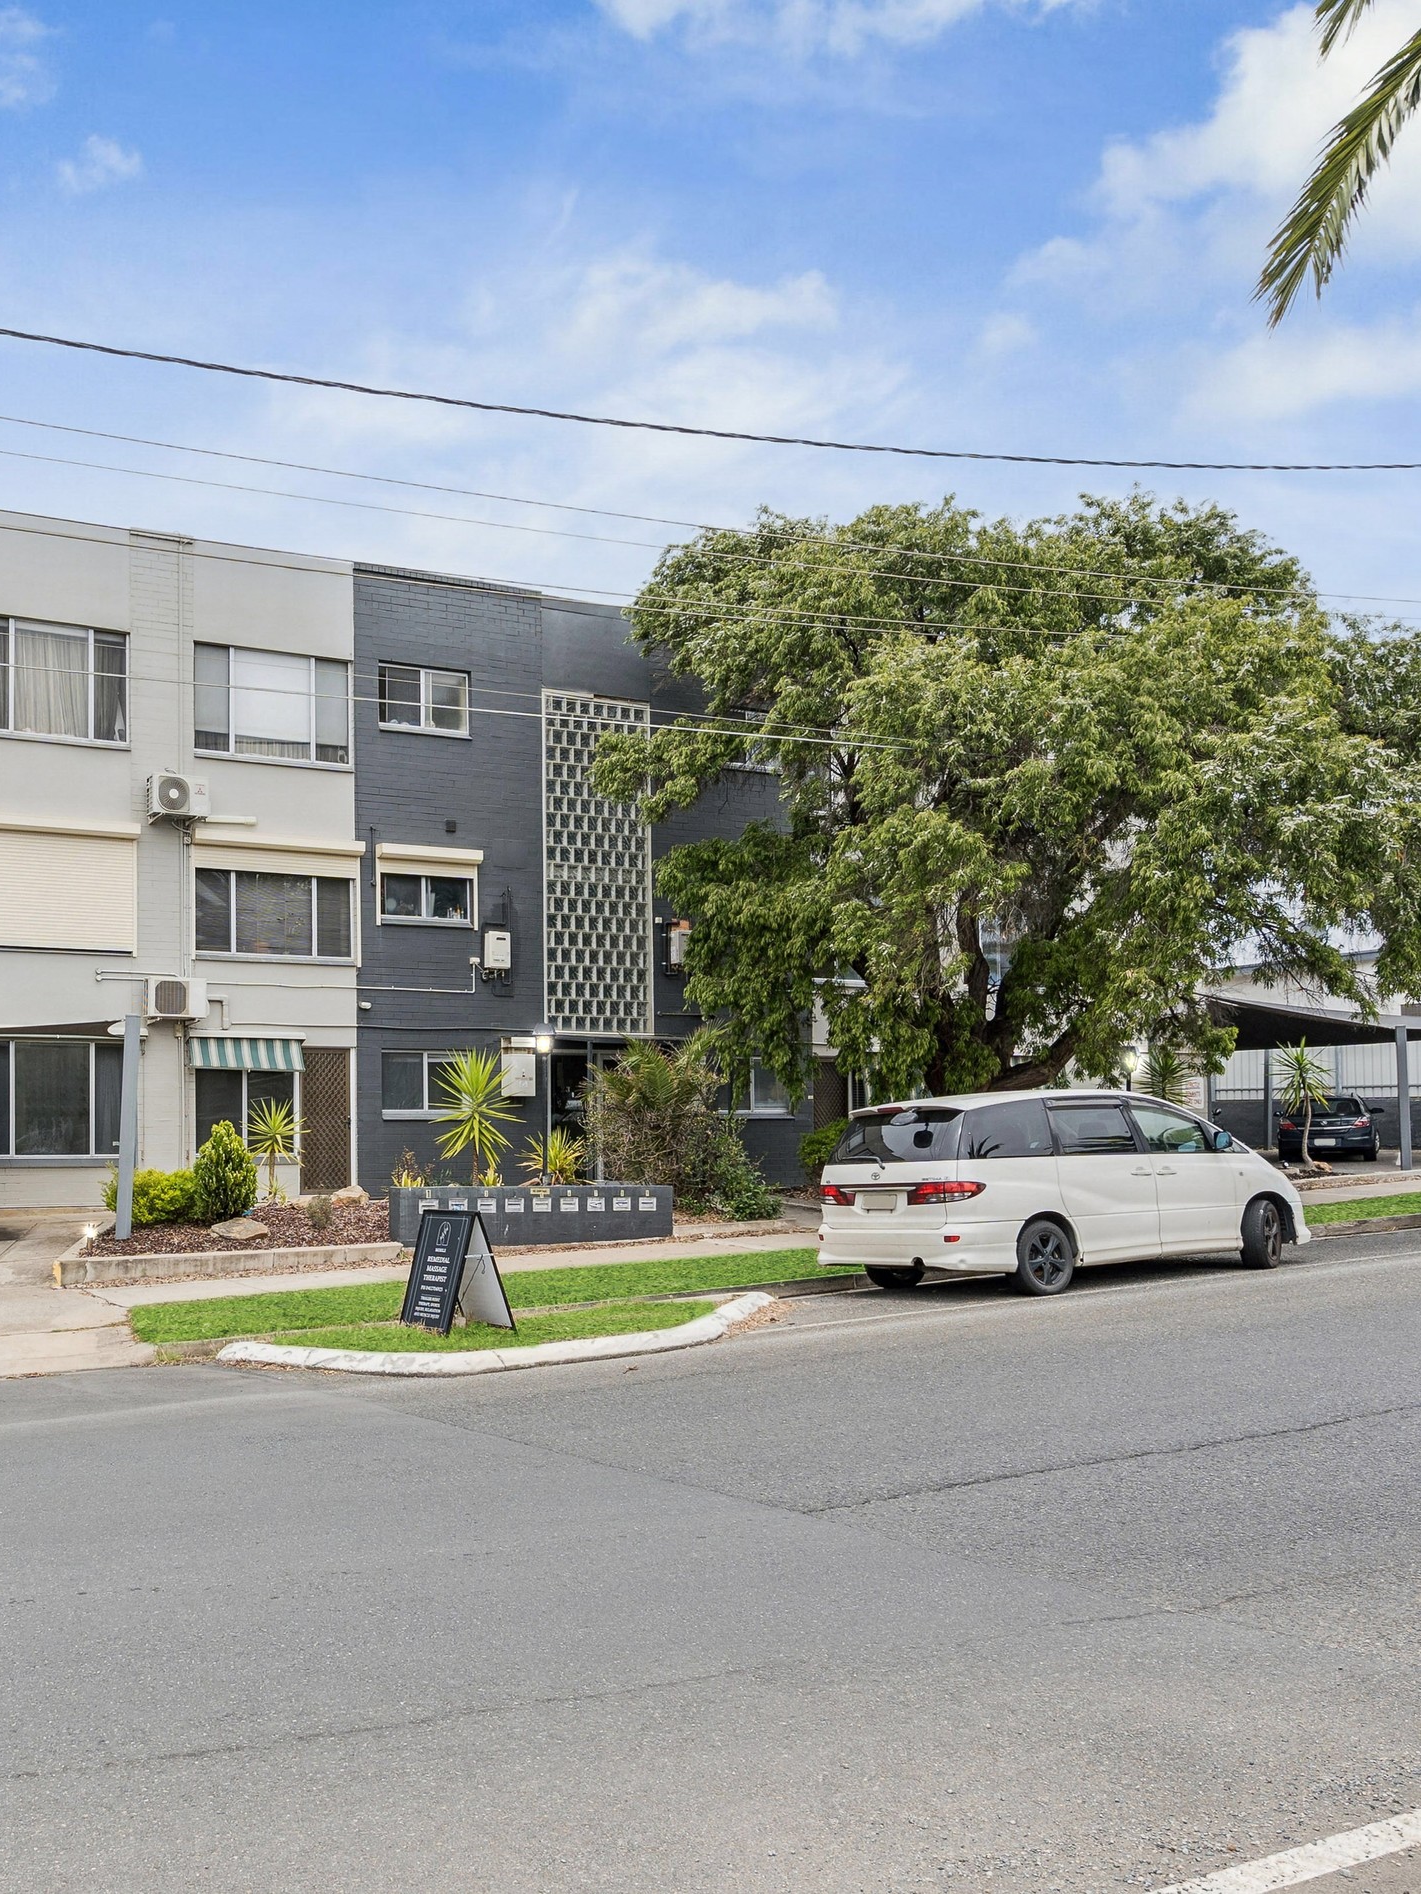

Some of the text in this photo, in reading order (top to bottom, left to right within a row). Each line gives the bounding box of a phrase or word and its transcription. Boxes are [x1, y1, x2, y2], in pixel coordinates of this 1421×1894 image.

[427, 1256, 450, 1264] REMEDIAL
[426, 1265, 448, 1273] MASSAGE
[423, 1274, 447, 1282] THERAPIST
